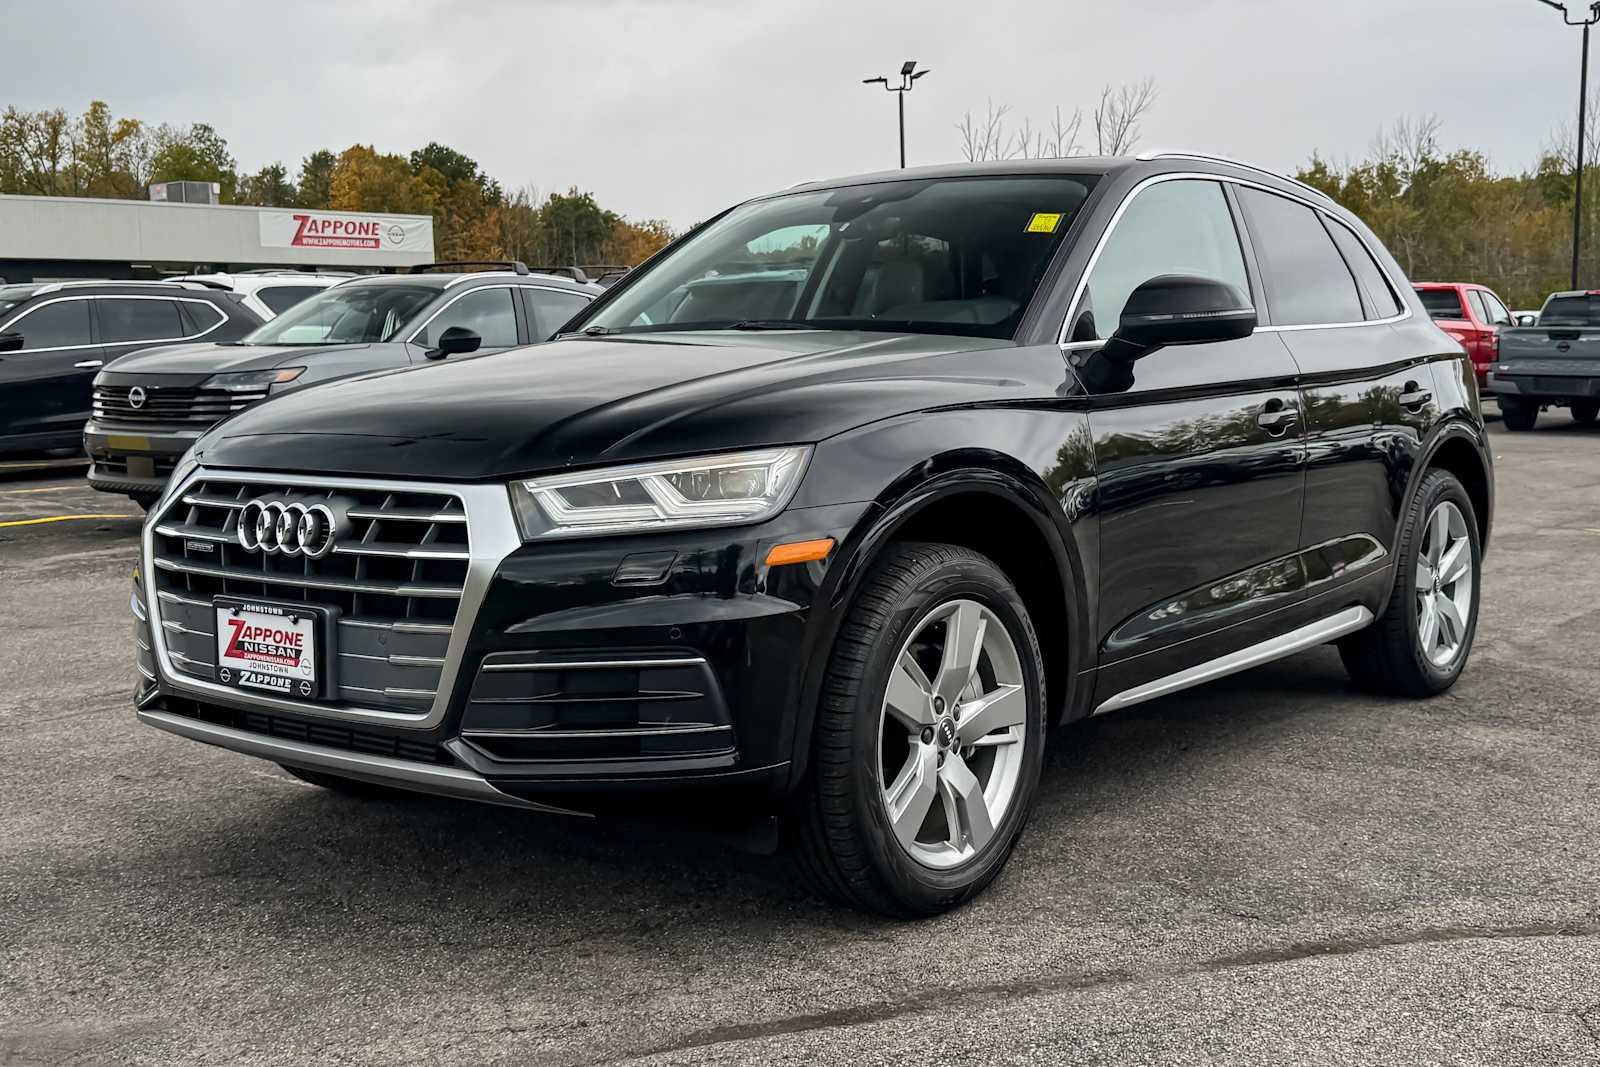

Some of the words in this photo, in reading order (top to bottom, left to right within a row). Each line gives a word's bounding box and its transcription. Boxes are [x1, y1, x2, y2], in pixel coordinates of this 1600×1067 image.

[291, 214, 380, 246] ZAPPONE
[242, 604, 283, 615] JOHNSTOWN
[224, 618, 304, 657] ZAPPONE
[244, 642, 296, 658] NISSAN
[243, 652, 296, 666] ZAPPONENISSAN.COM
[249, 661, 289, 674] JOHNSTOWN
[238, 670, 292, 693] ZAPPONE
